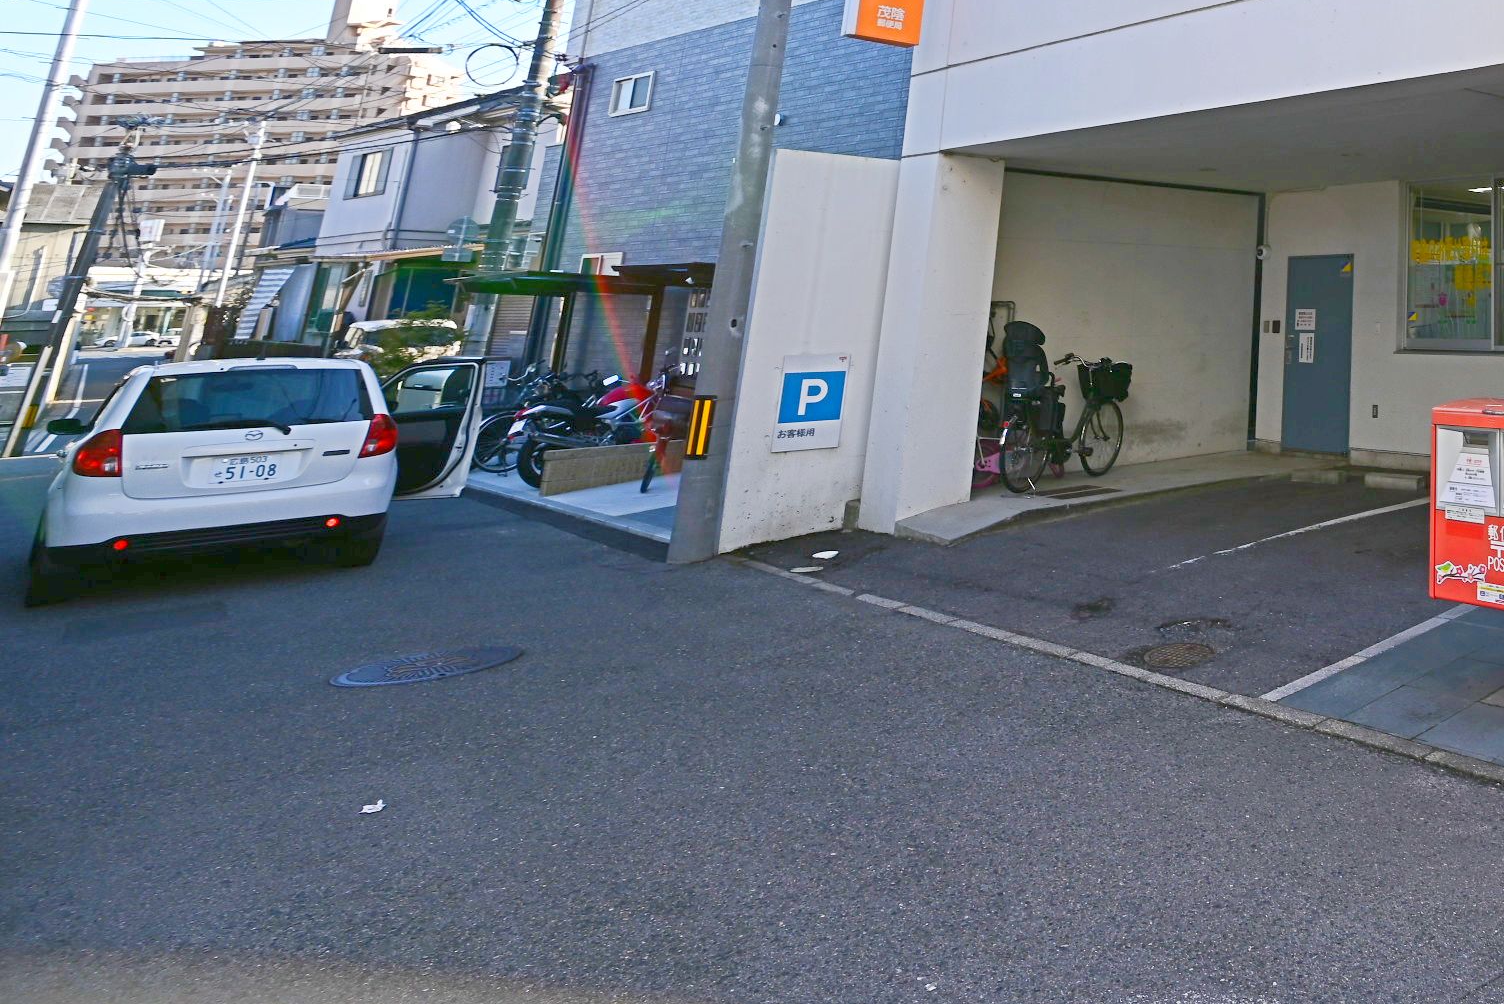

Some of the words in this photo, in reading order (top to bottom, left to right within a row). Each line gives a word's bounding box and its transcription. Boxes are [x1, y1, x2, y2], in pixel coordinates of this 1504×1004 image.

[877, 4, 906, 21] 茂陰
[797, 378, 829, 416] P
[776, 427, 816, 439] お客様用
[225, 463, 277, 480] 51-08
